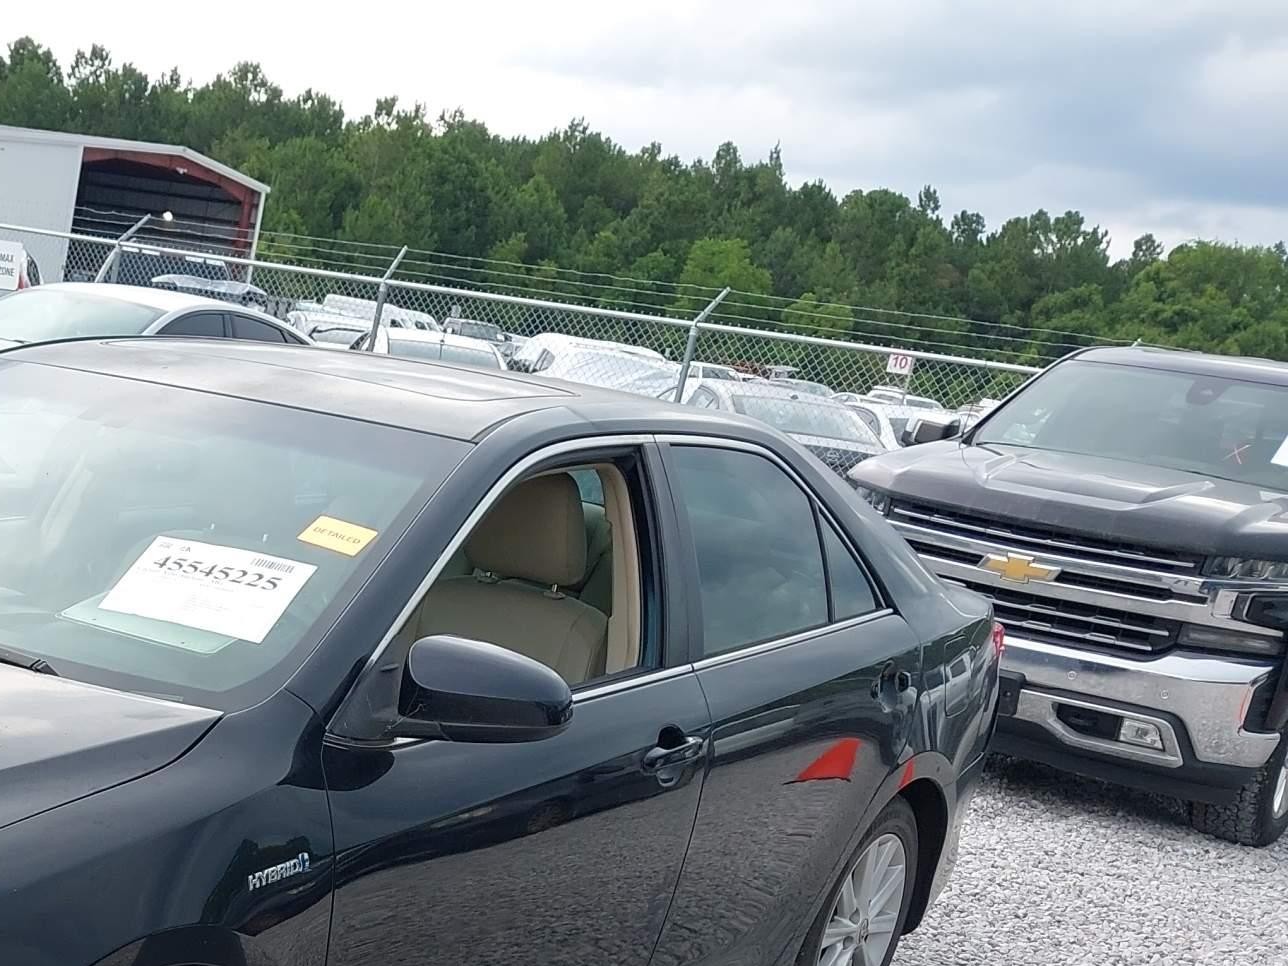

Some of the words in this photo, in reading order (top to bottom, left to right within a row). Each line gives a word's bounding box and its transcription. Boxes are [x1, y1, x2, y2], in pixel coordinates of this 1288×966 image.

[892, 355, 909, 370] 10
[312, 526, 362, 545] DETAILED
[153, 555, 283, 591] 45545225
[248, 858, 301, 891] HYBRID
